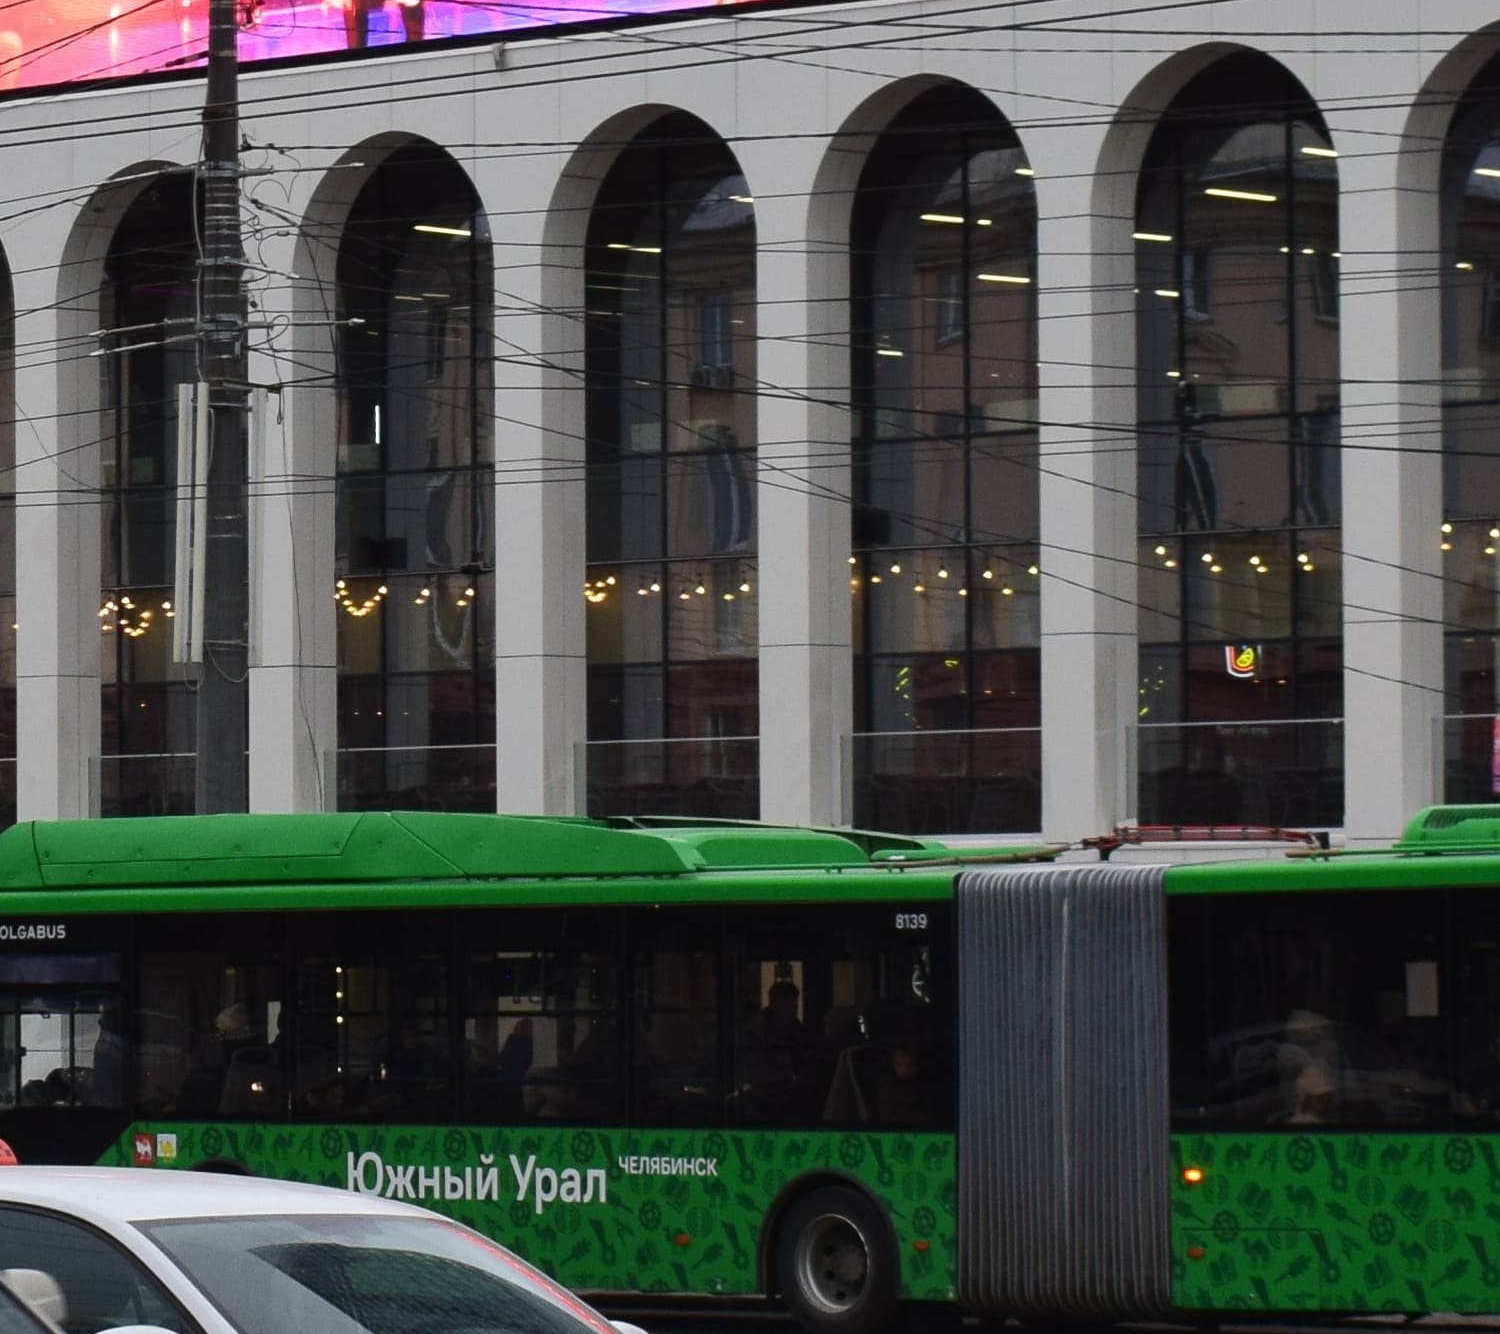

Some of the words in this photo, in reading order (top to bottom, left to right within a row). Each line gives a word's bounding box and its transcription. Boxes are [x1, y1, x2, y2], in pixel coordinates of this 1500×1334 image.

[894, 913, 928, 930] 8139
[618, 1156, 718, 1177] ЧЕЛЯБИНСК
[346, 1151, 499, 1201] Южный
[508, 1154, 607, 1215] Урал
